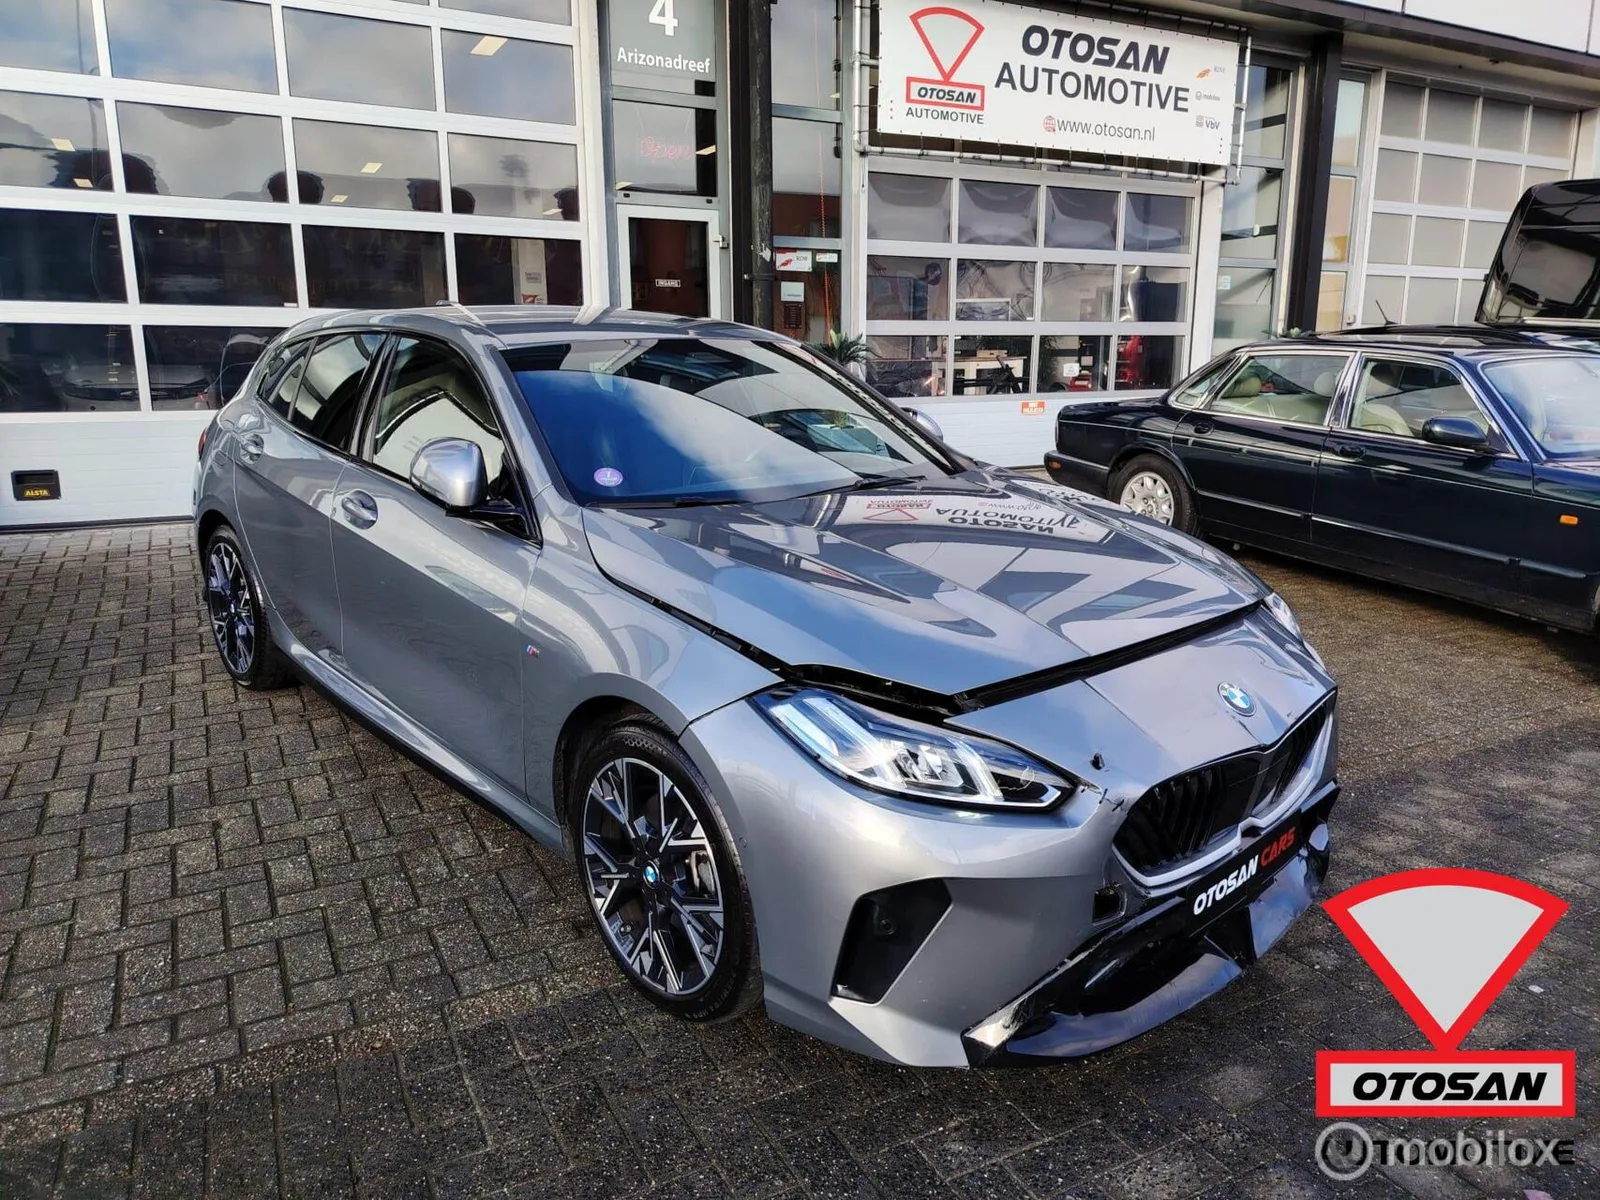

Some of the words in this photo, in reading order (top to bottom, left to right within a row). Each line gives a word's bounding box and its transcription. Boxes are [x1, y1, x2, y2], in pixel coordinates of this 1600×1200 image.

[648, 0, 679, 36] 4
[616, 47, 711, 73] Arizonadreef
[1022, 24, 1170, 74] OTOSAN
[917, 86, 977, 104] OTOSAN
[994, 61, 1190, 112] AUTOMOTIVE
[905, 106, 985, 125] AUTOMOTIVE
[1205, 119, 1221, 130] VbV
[1057, 118, 1155, 141] www.otosan.nl
[1193, 854, 1260, 916] OTOSAN
[1260, 826, 1296, 867] CARS
